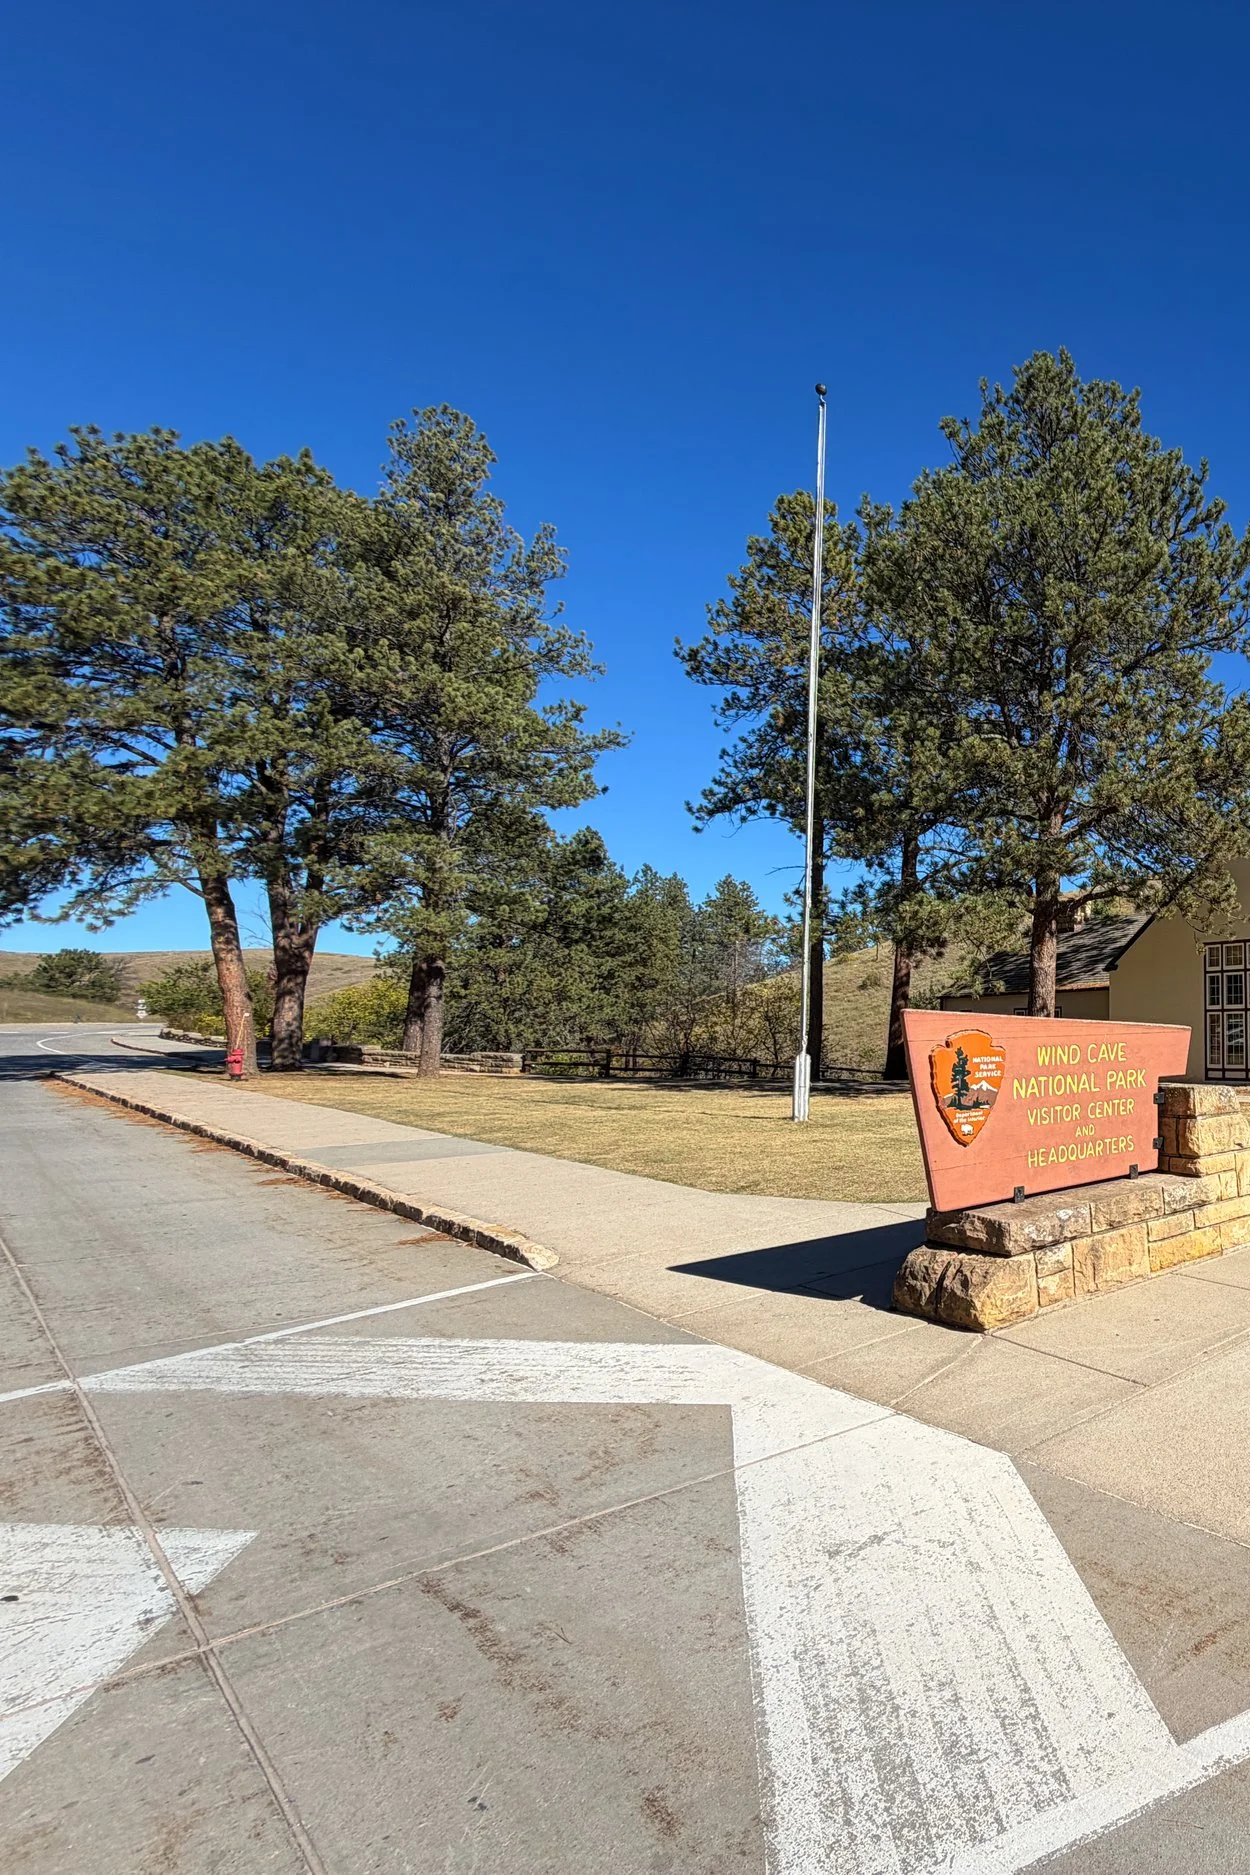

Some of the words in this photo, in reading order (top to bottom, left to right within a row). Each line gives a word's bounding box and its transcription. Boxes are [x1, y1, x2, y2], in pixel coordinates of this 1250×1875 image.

[1037, 1044, 1081, 1066] WIND
[1087, 1042, 1127, 1063] CAVE
[974, 1070, 1002, 1078] SERVICE
[1013, 1073, 1100, 1100] NATIONAL
[1107, 1069, 1147, 1090] PARK
[1027, 1104, 1080, 1126] VISITOR
[1087, 1098, 1135, 1119] CENTER
[1075, 1123, 1095, 1137] AND
[1027, 1135, 1135, 1168] HEADQUARTERS
